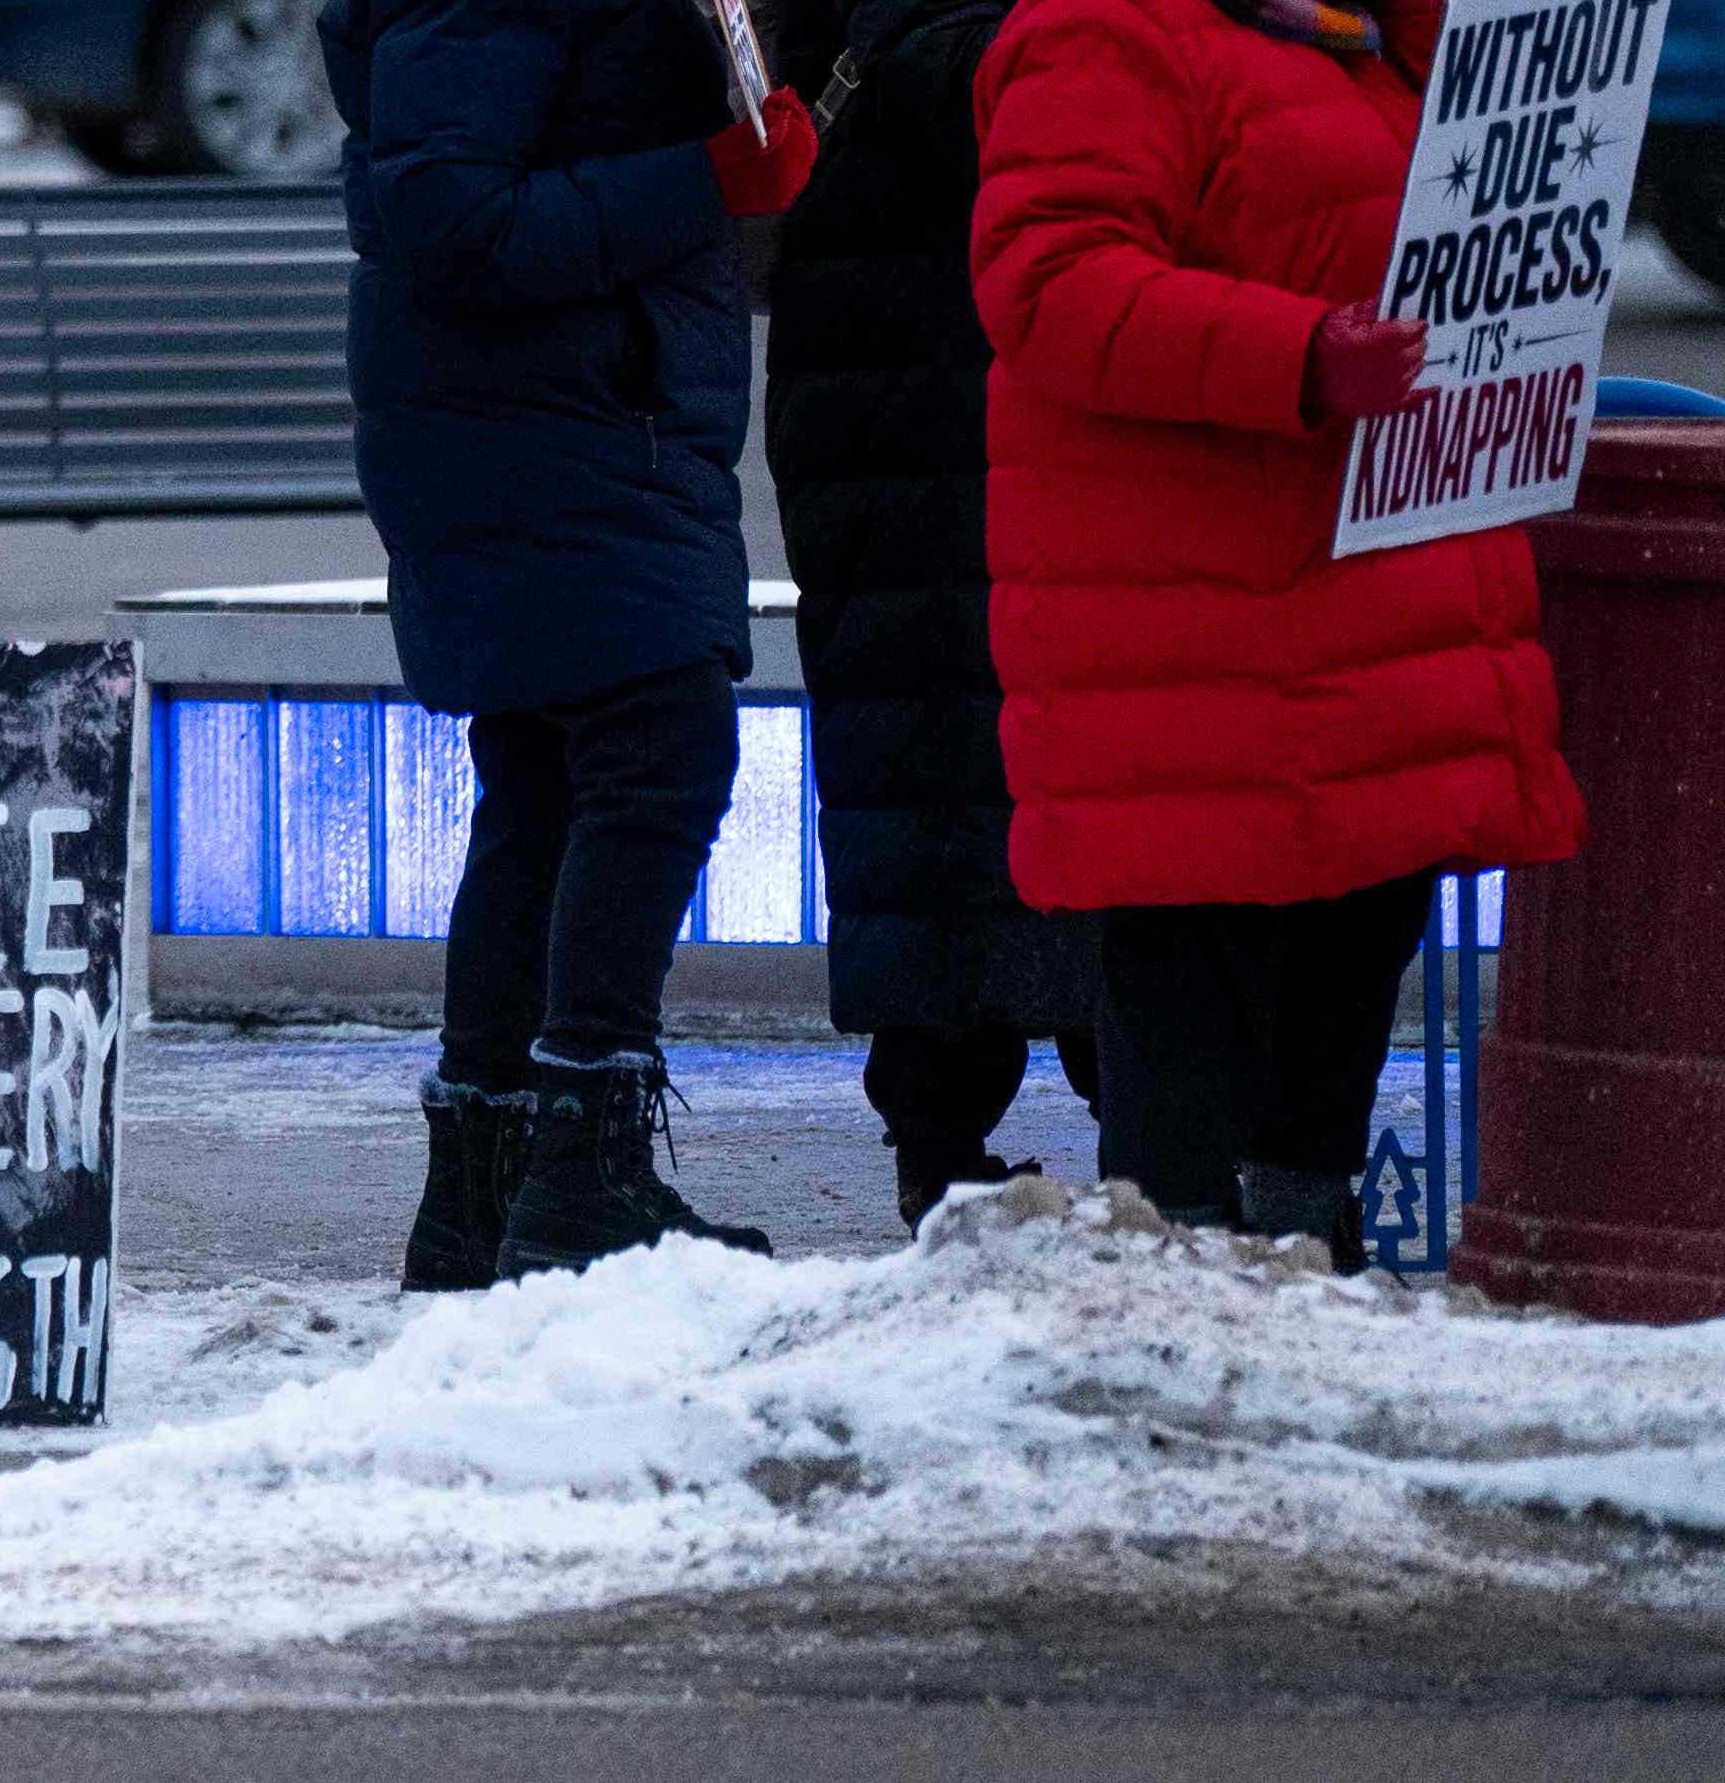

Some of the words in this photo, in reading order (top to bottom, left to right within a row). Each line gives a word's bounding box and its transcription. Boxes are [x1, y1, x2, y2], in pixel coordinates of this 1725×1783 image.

[1469, 105, 1577, 219] DUE
[1388, 198, 1615, 327] PROCESS,
[1461, 319, 1511, 379] IT'S
[1349, 361, 1585, 524] KIDNAPPING
